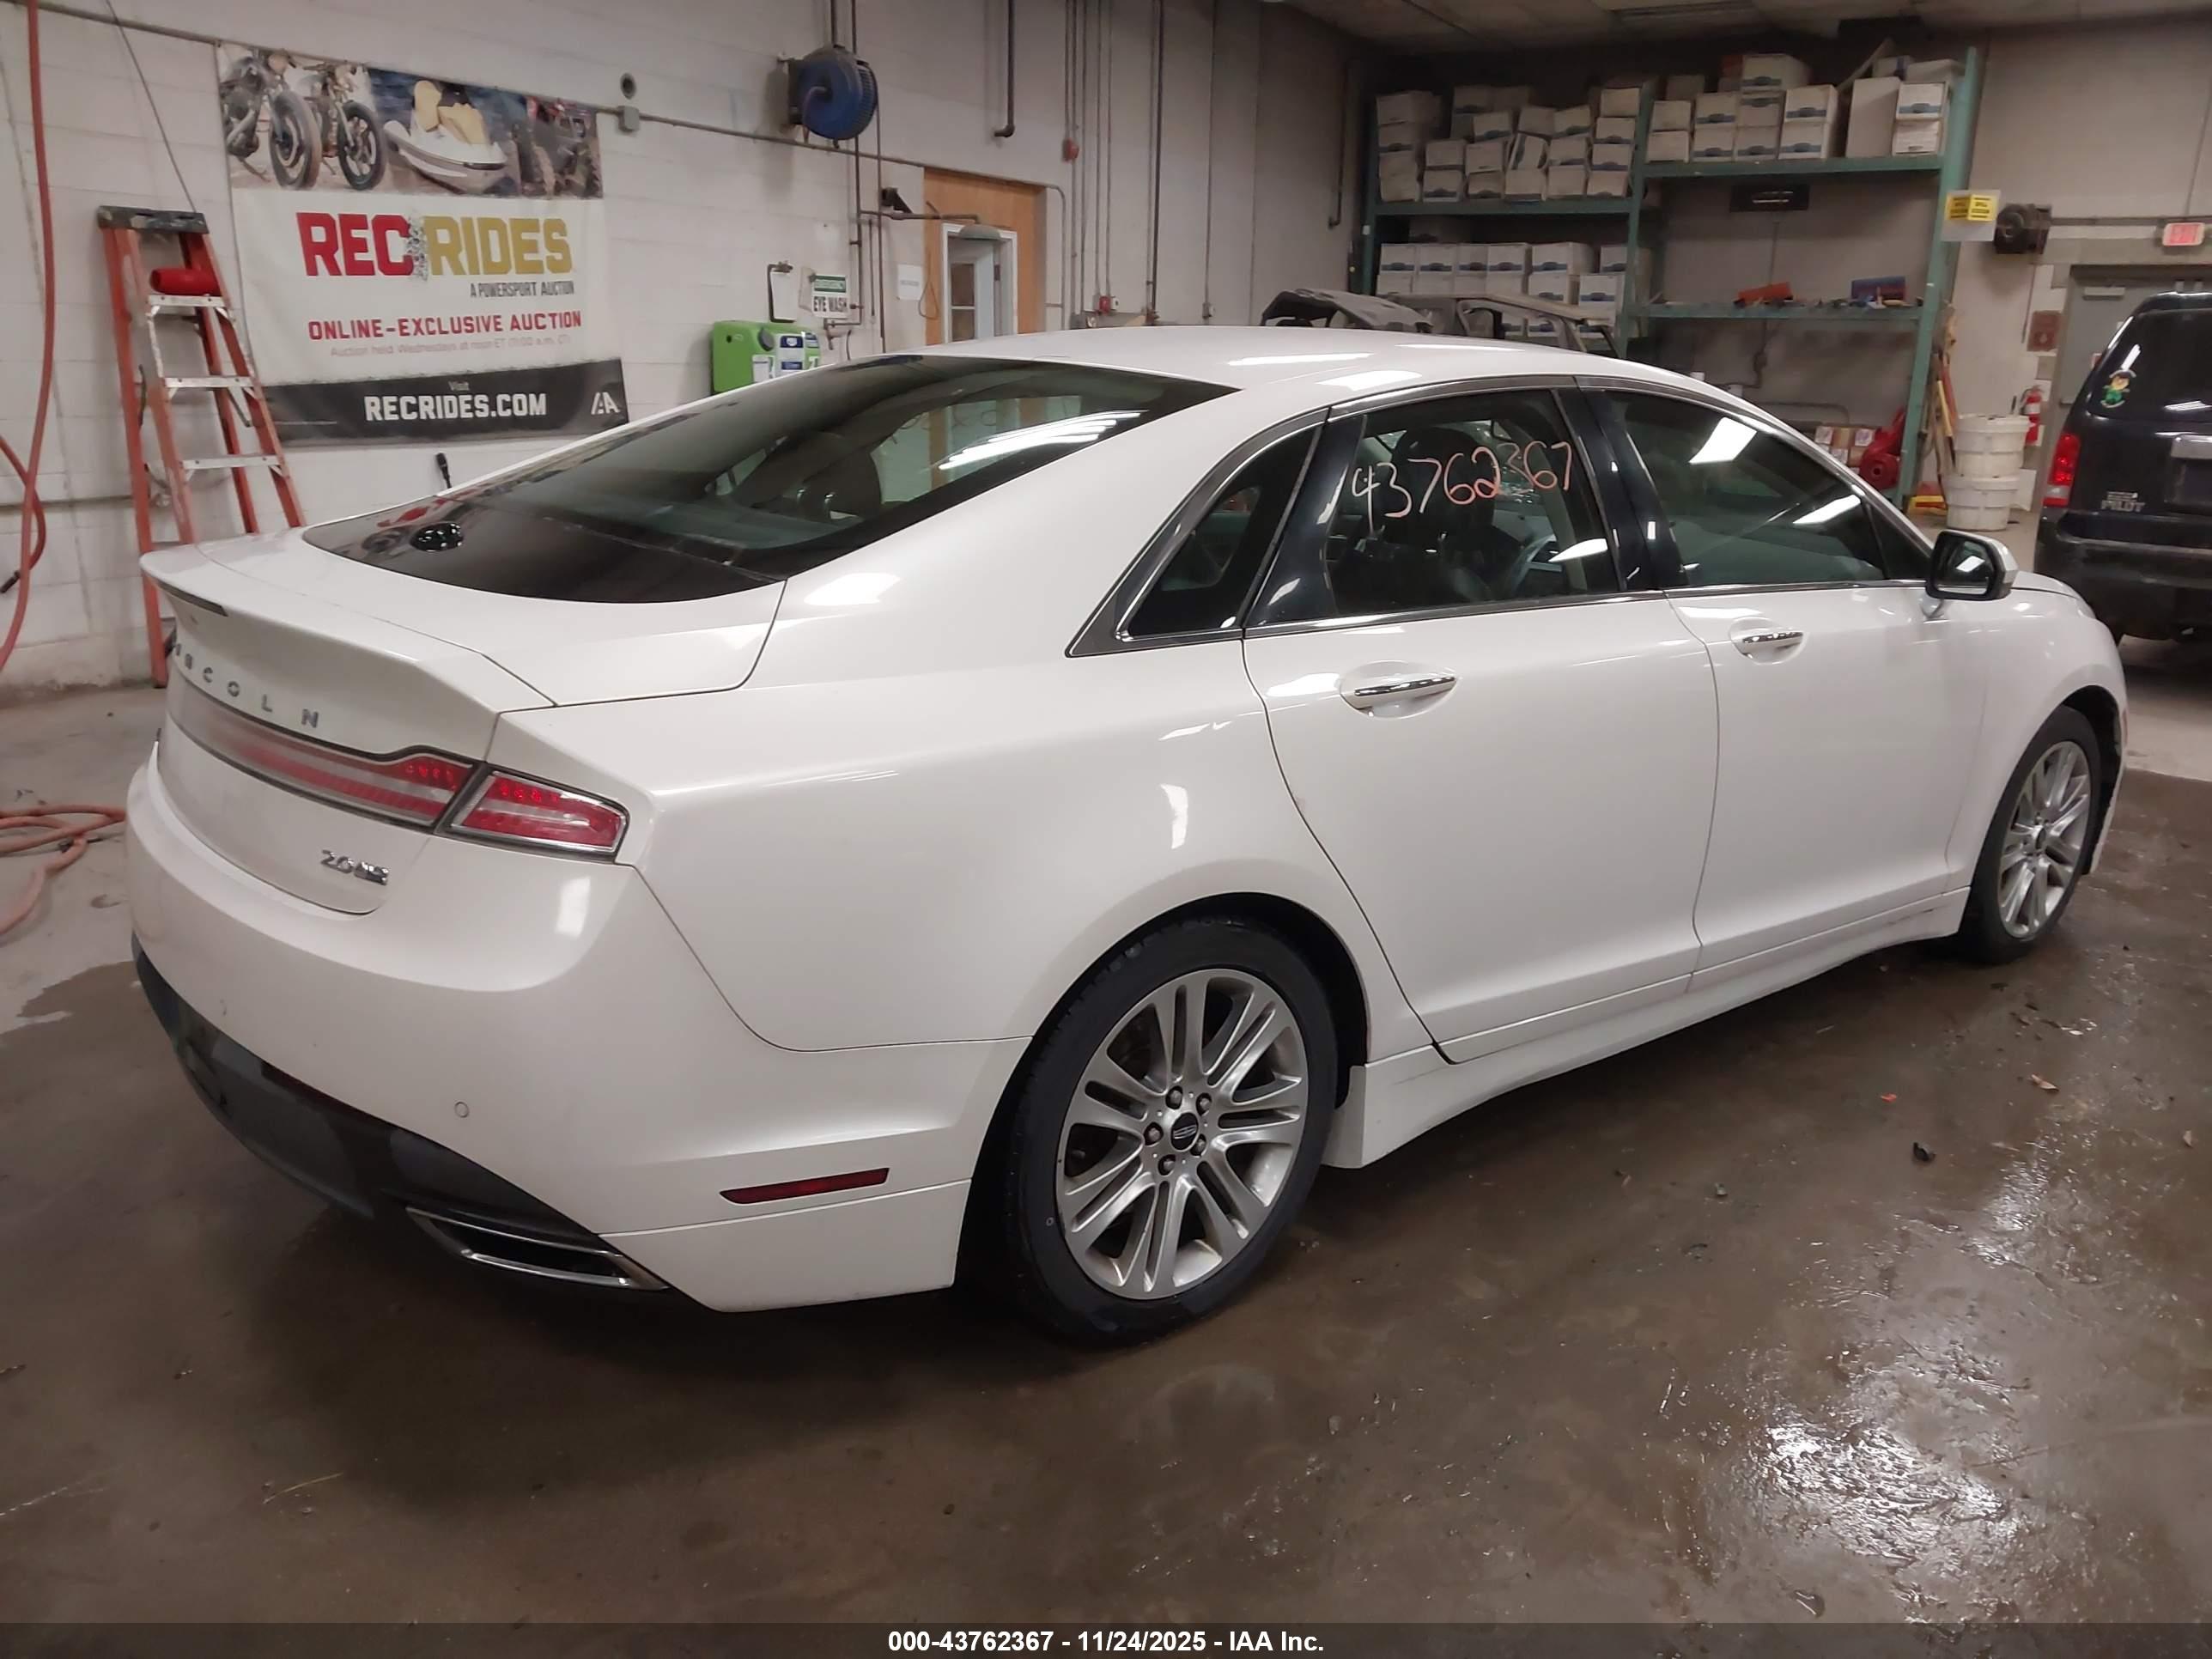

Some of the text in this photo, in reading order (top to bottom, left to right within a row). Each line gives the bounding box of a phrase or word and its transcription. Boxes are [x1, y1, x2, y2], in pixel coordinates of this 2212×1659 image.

[424, 216, 574, 276] RIDES
[541, 280, 574, 296] AUCTION
[308, 311, 581, 340] ONLINE-EXCLUSIVE AUCTION
[364, 392, 547, 422] RECRIDES.COM
[1352, 441, 1573, 534] 43762367
